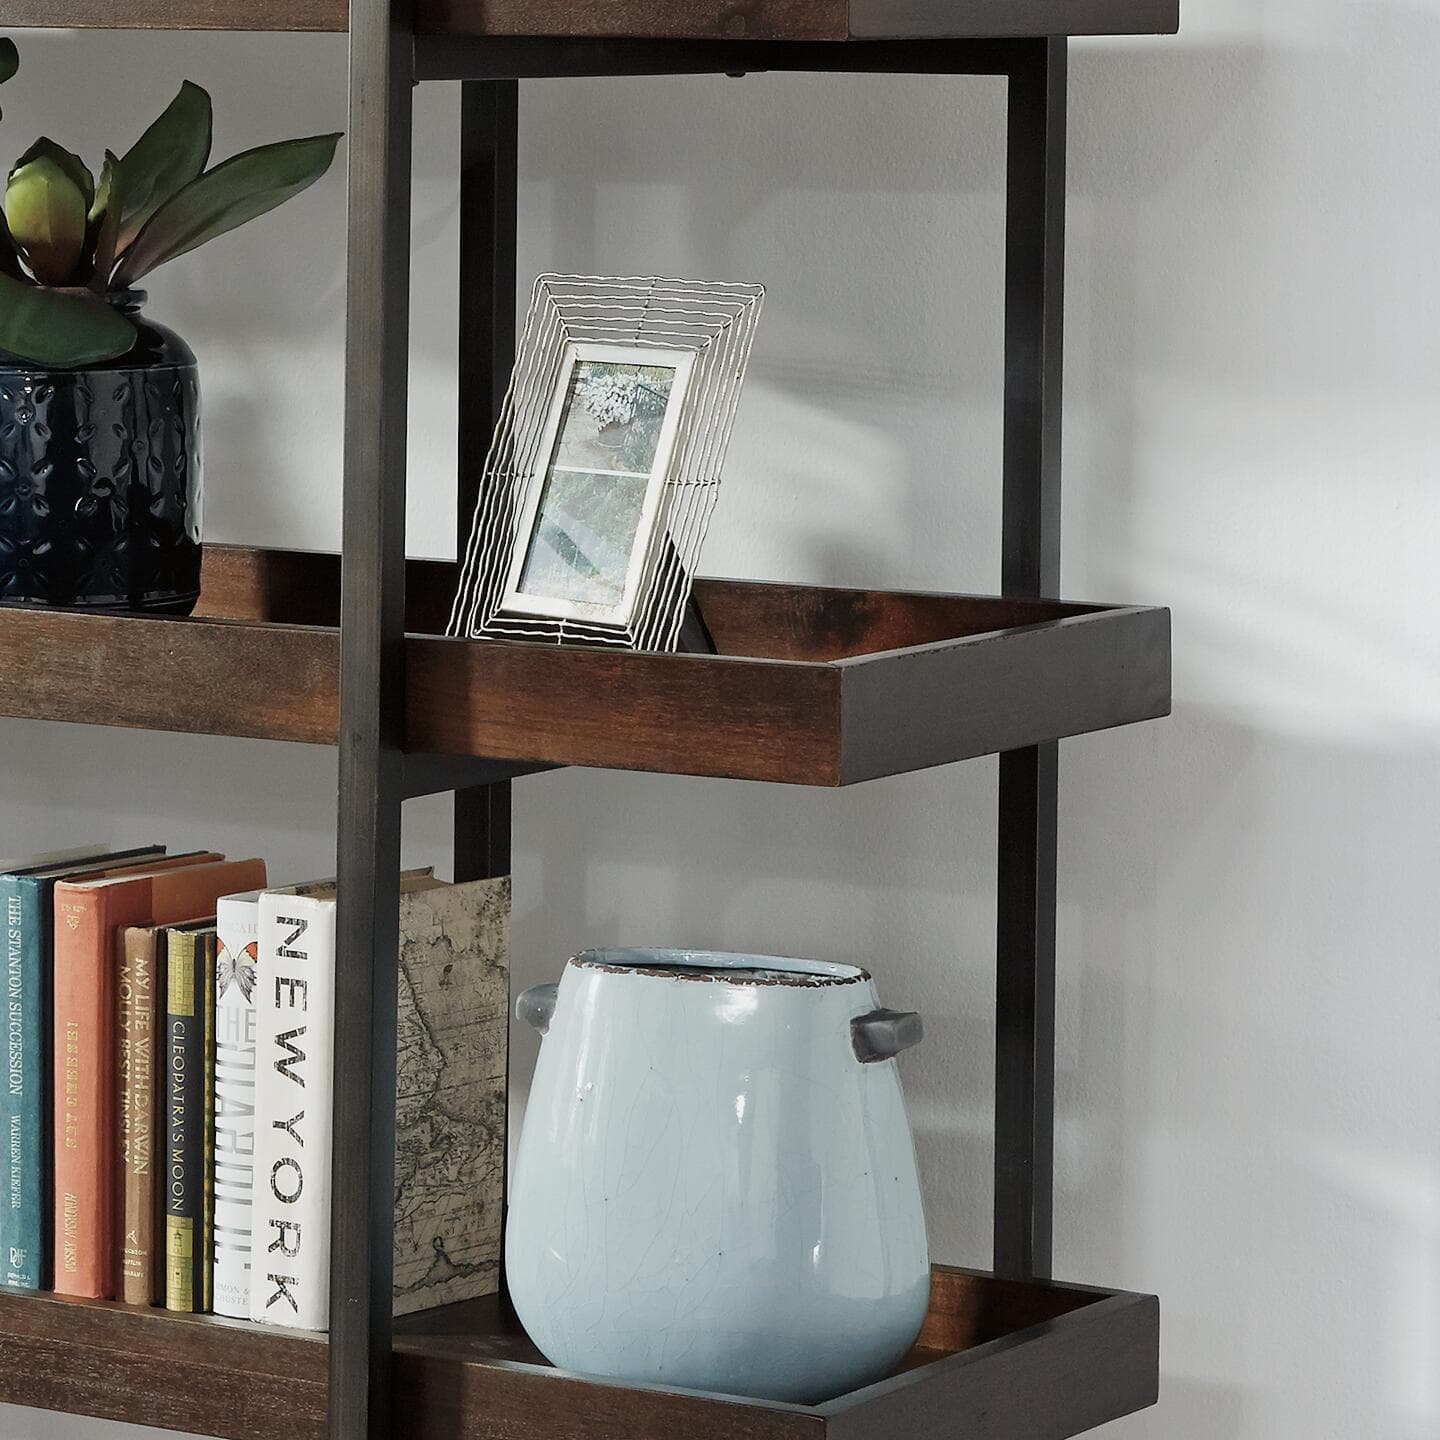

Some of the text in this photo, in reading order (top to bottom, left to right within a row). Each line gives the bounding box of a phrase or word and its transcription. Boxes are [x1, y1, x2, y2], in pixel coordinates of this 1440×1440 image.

[7, 895, 23, 1209] THE STANTON SUCCESSION WARREN KIEFER
[119, 965, 133, 1032] MOLLY
[119, 1038, 132, 1082] BEST
[132, 958, 150, 1176] MY LIFE WITH DARWIN
[171, 1020, 186, 1212] CLEOPATRA'S MOON
[265, 915, 308, 1314] NEW YORK
